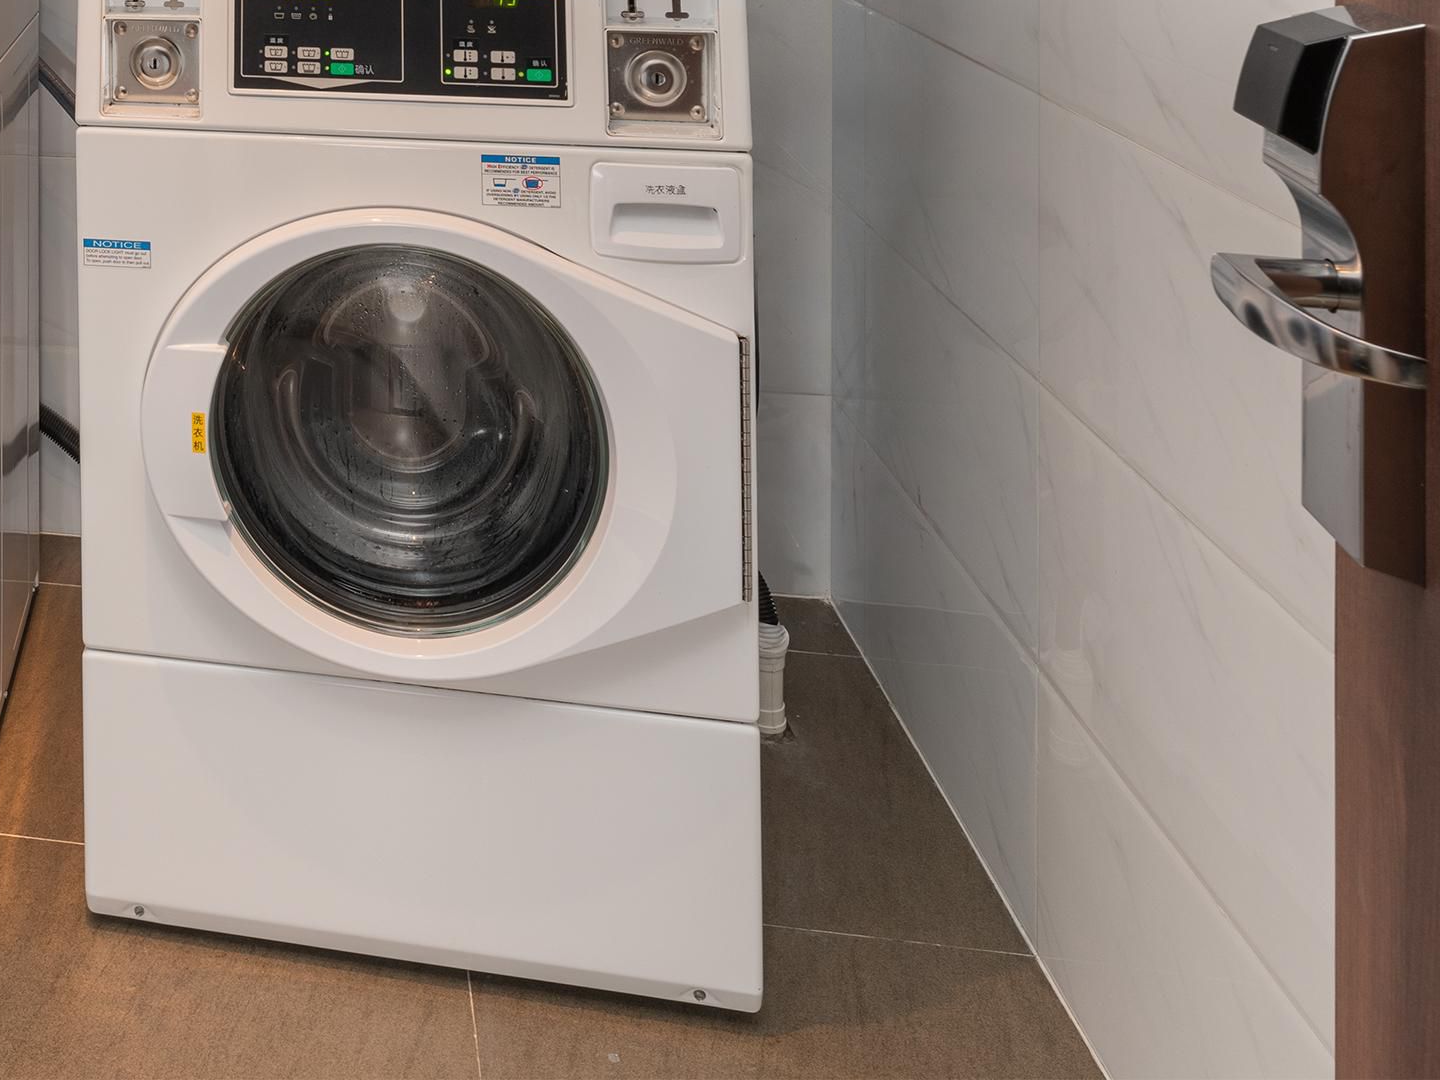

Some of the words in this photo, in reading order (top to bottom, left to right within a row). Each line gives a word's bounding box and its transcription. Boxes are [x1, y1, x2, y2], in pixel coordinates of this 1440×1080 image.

[355, 64, 375, 75] 确认
[645, 184, 688, 196] 洗衣液盒
[92, 240, 142, 249] NOTICE
[193, 415, 204, 451] 洗衣机
